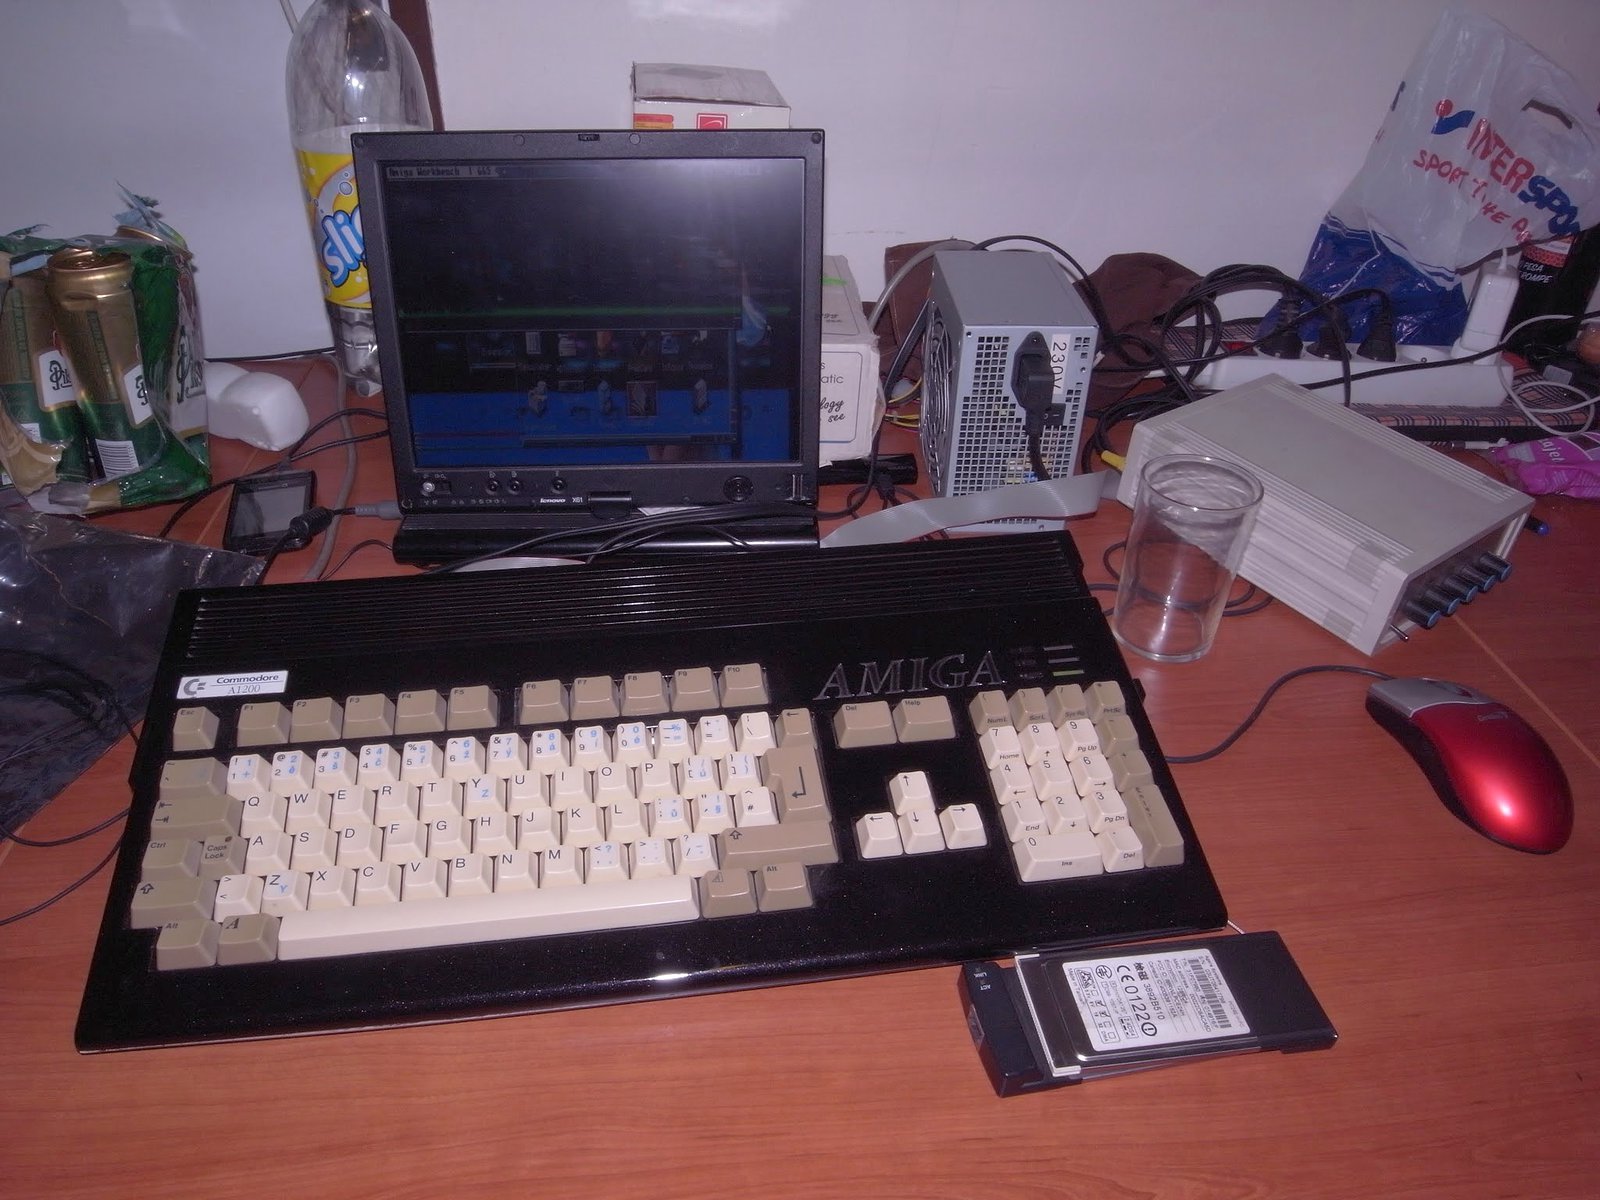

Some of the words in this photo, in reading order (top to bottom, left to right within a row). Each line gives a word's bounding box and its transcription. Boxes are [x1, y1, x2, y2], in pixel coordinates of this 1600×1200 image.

[1413, 150, 1469, 189] SPORT
[1466, 118, 1581, 236] INTERSPO
[1051, 342, 1067, 389] 230V
[821, 374, 844, 384] atic
[820, 397, 844, 413] logy
[216, 674, 279, 684] Commodore
[812, 650, 1006, 700] AMIGA
[228, 685, 261, 695] A1200
[602, 767, 612, 776] O
[645, 764, 653, 772] P
[472, 779, 480, 787] Y
[515, 776, 525, 784] U
[382, 786, 392, 795] R
[428, 783, 436, 792] T
[294, 794, 308, 803] W
[338, 790, 346, 799] E
[1096, 792, 1104, 800] 3
[248, 797, 260, 806] Q
[572, 808, 580, 818] K
[615, 805, 622, 814] L
[481, 817, 490, 826] H
[526, 812, 534, 822] J
[391, 824, 399, 833] F
[436, 821, 447, 830] G
[300, 832, 309, 842] S
[345, 829, 355, 838] D
[253, 836, 263, 845] A
[1029, 838, 1036, 846] 0
[549, 850, 560, 859] M
[456, 859, 466, 868] B
[502, 855, 512, 864] N
[363, 867, 374, 877] C
[411, 863, 420, 872] V
[270, 875, 280, 885] Z
[316, 871, 327, 880] X
[1123, 985, 1151, 1020] 0122
